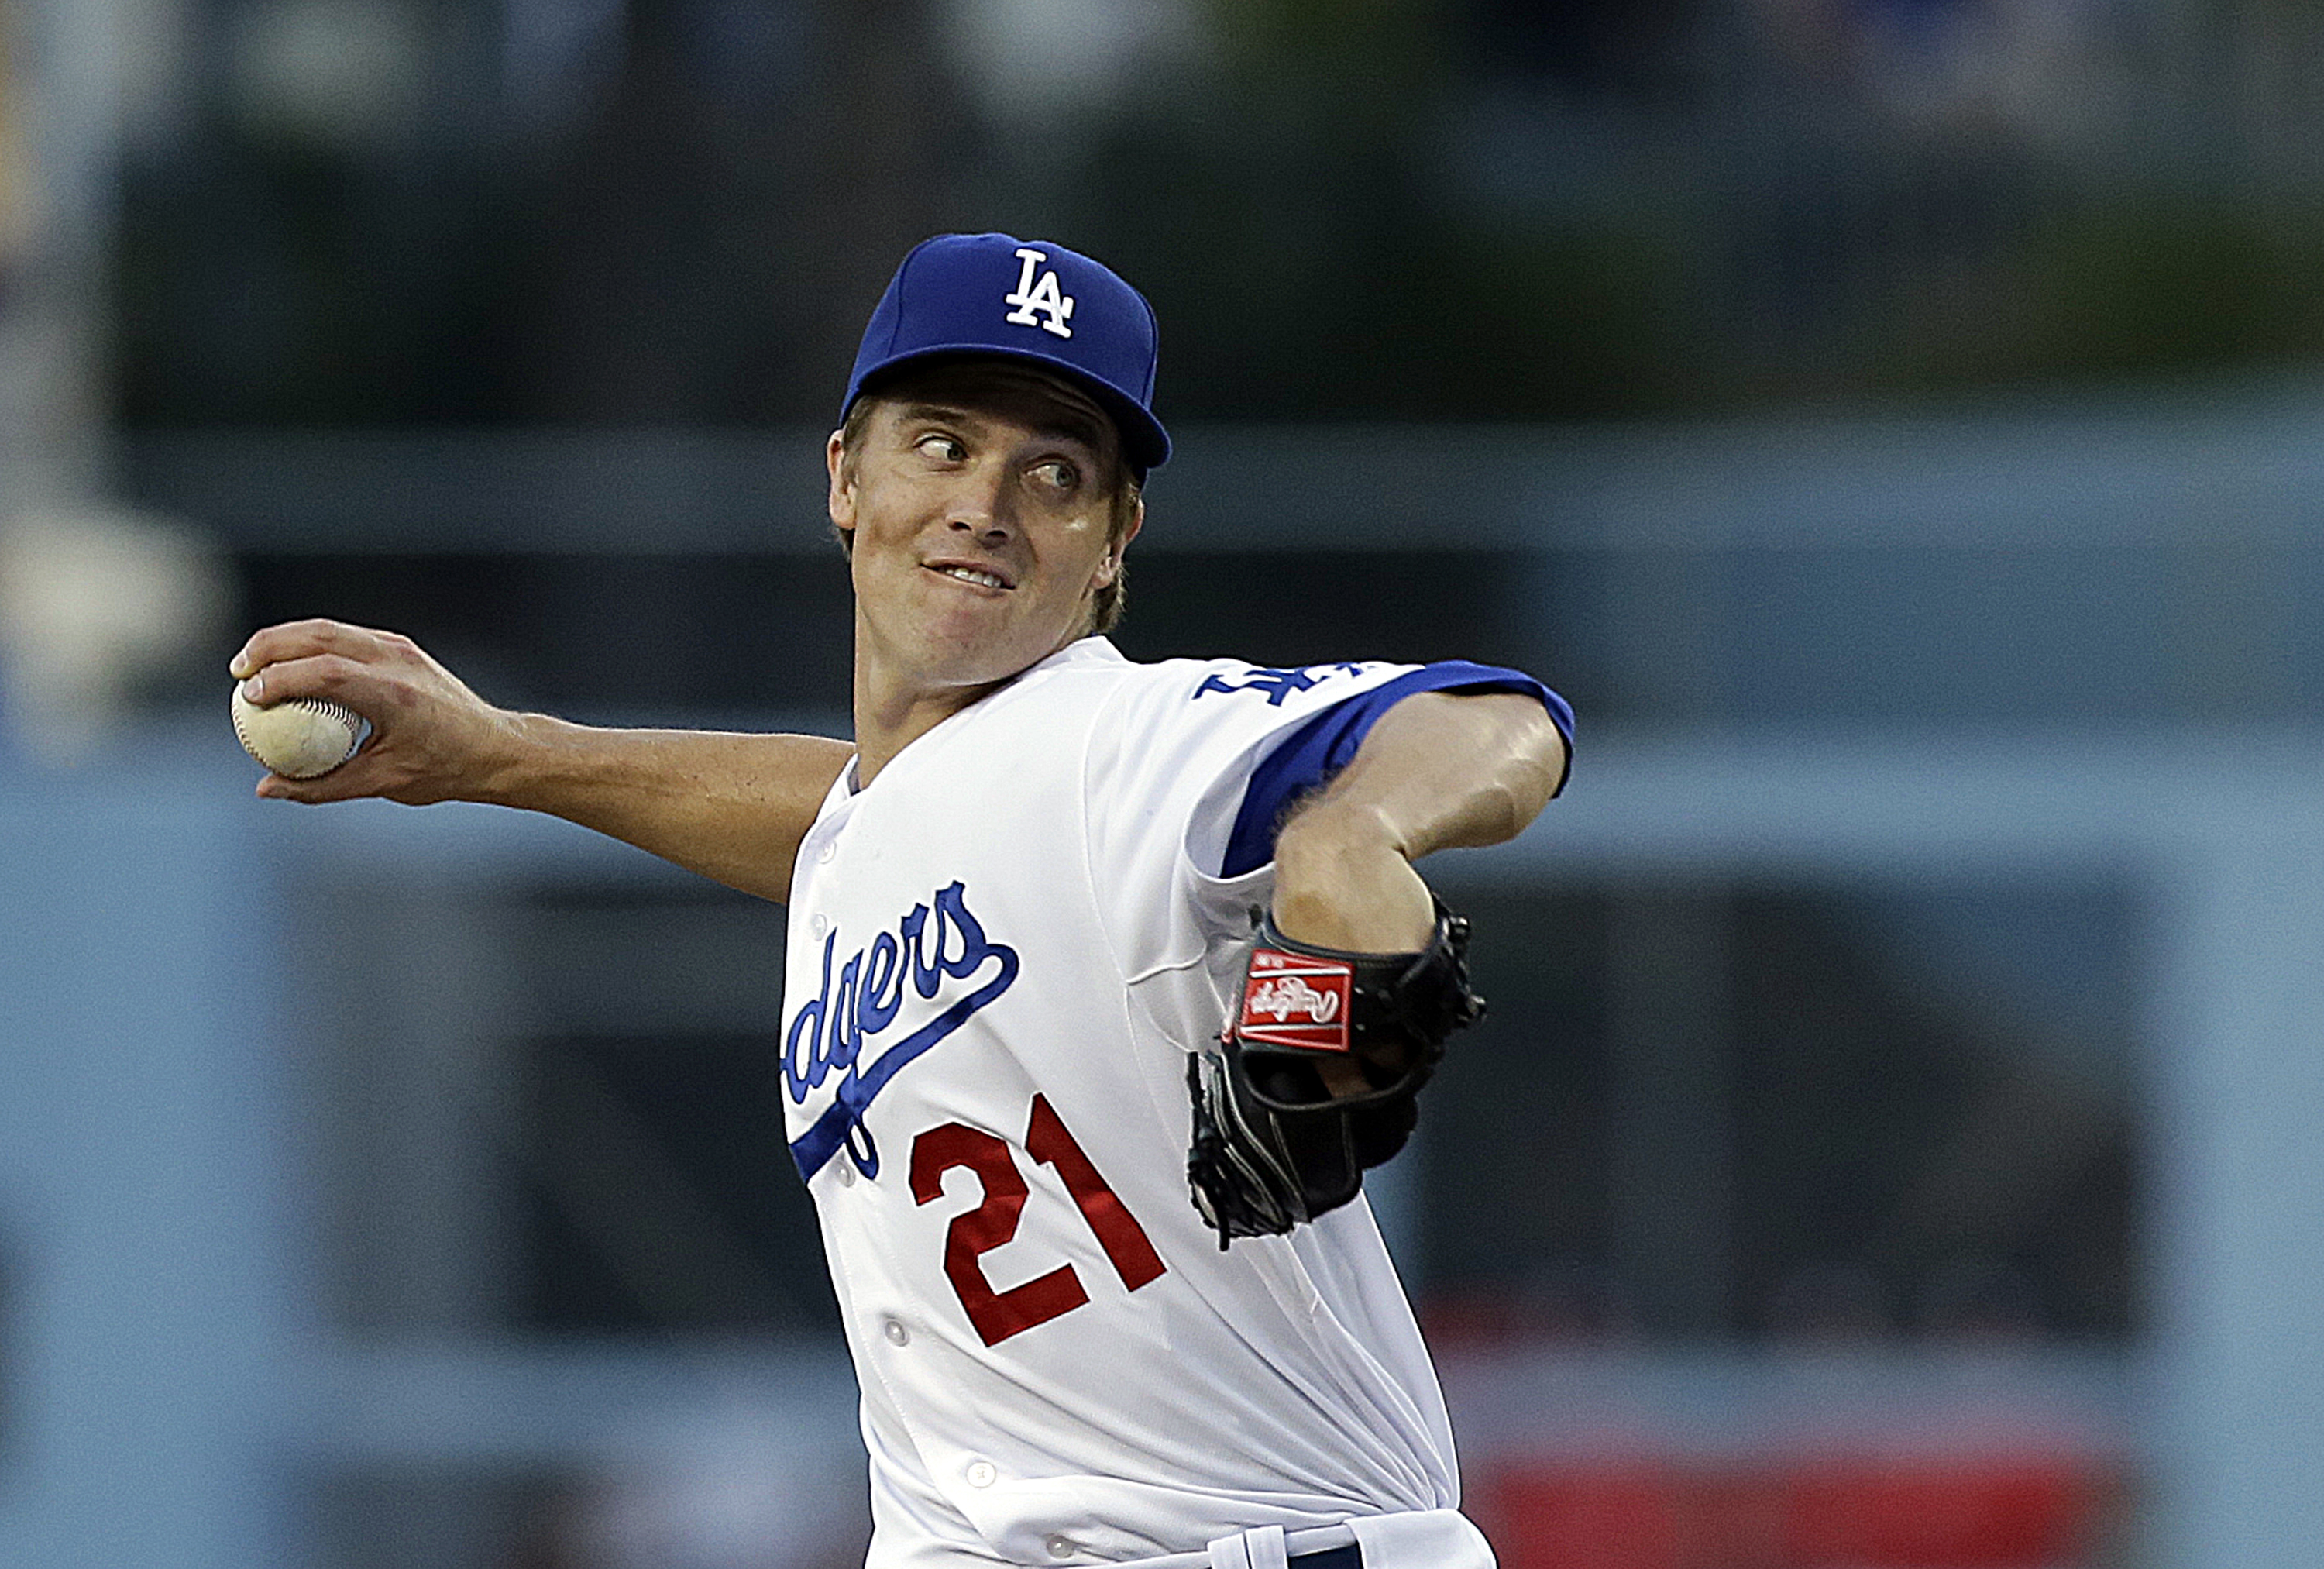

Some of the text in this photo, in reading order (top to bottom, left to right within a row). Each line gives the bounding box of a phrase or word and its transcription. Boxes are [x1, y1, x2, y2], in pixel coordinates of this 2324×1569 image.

[1006, 248, 1074, 338] LA
[780, 879, 1019, 1181] dgers
[909, 1092, 1168, 1348] 21
